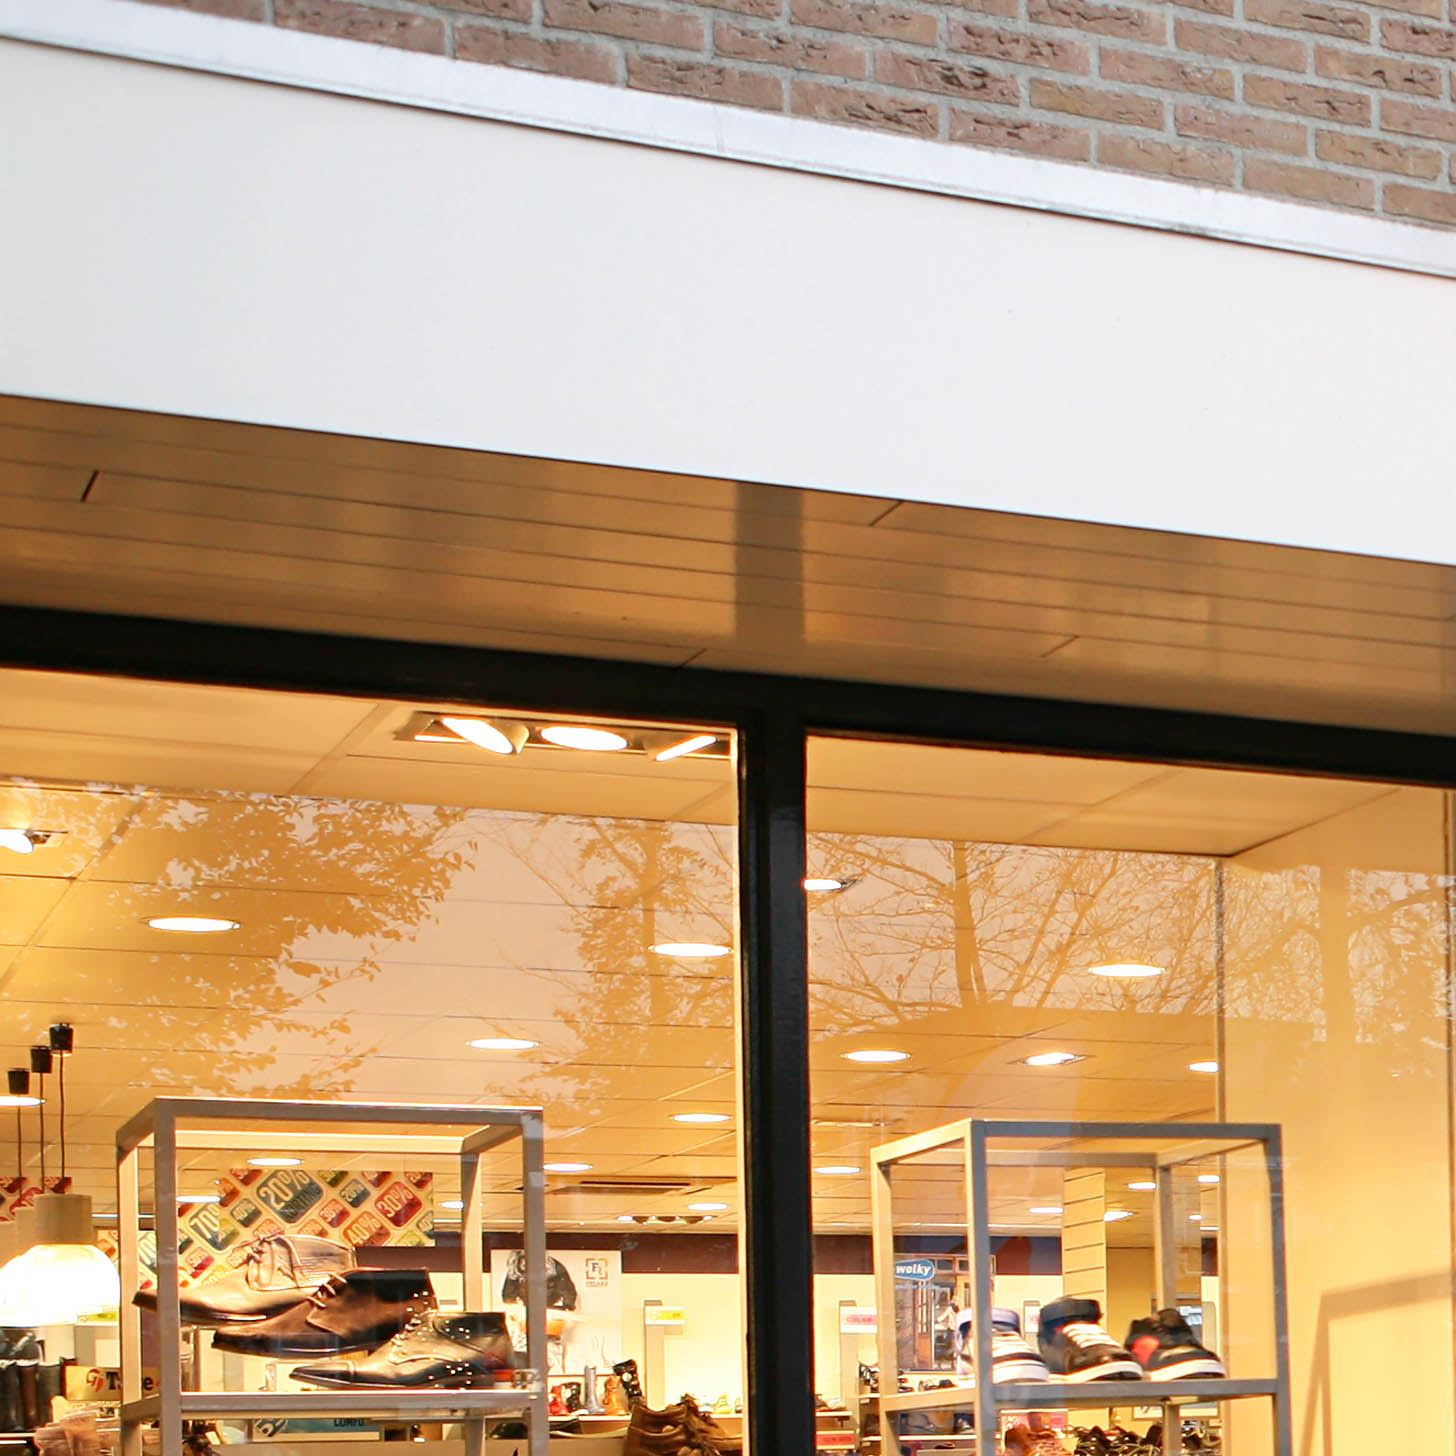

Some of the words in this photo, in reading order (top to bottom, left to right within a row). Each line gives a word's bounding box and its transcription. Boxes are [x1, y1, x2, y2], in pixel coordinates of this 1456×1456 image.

[260, 1169, 311, 1210] 20%
[376, 1184, 414, 1218] 30%
[347, 1212, 382, 1246] 40%
